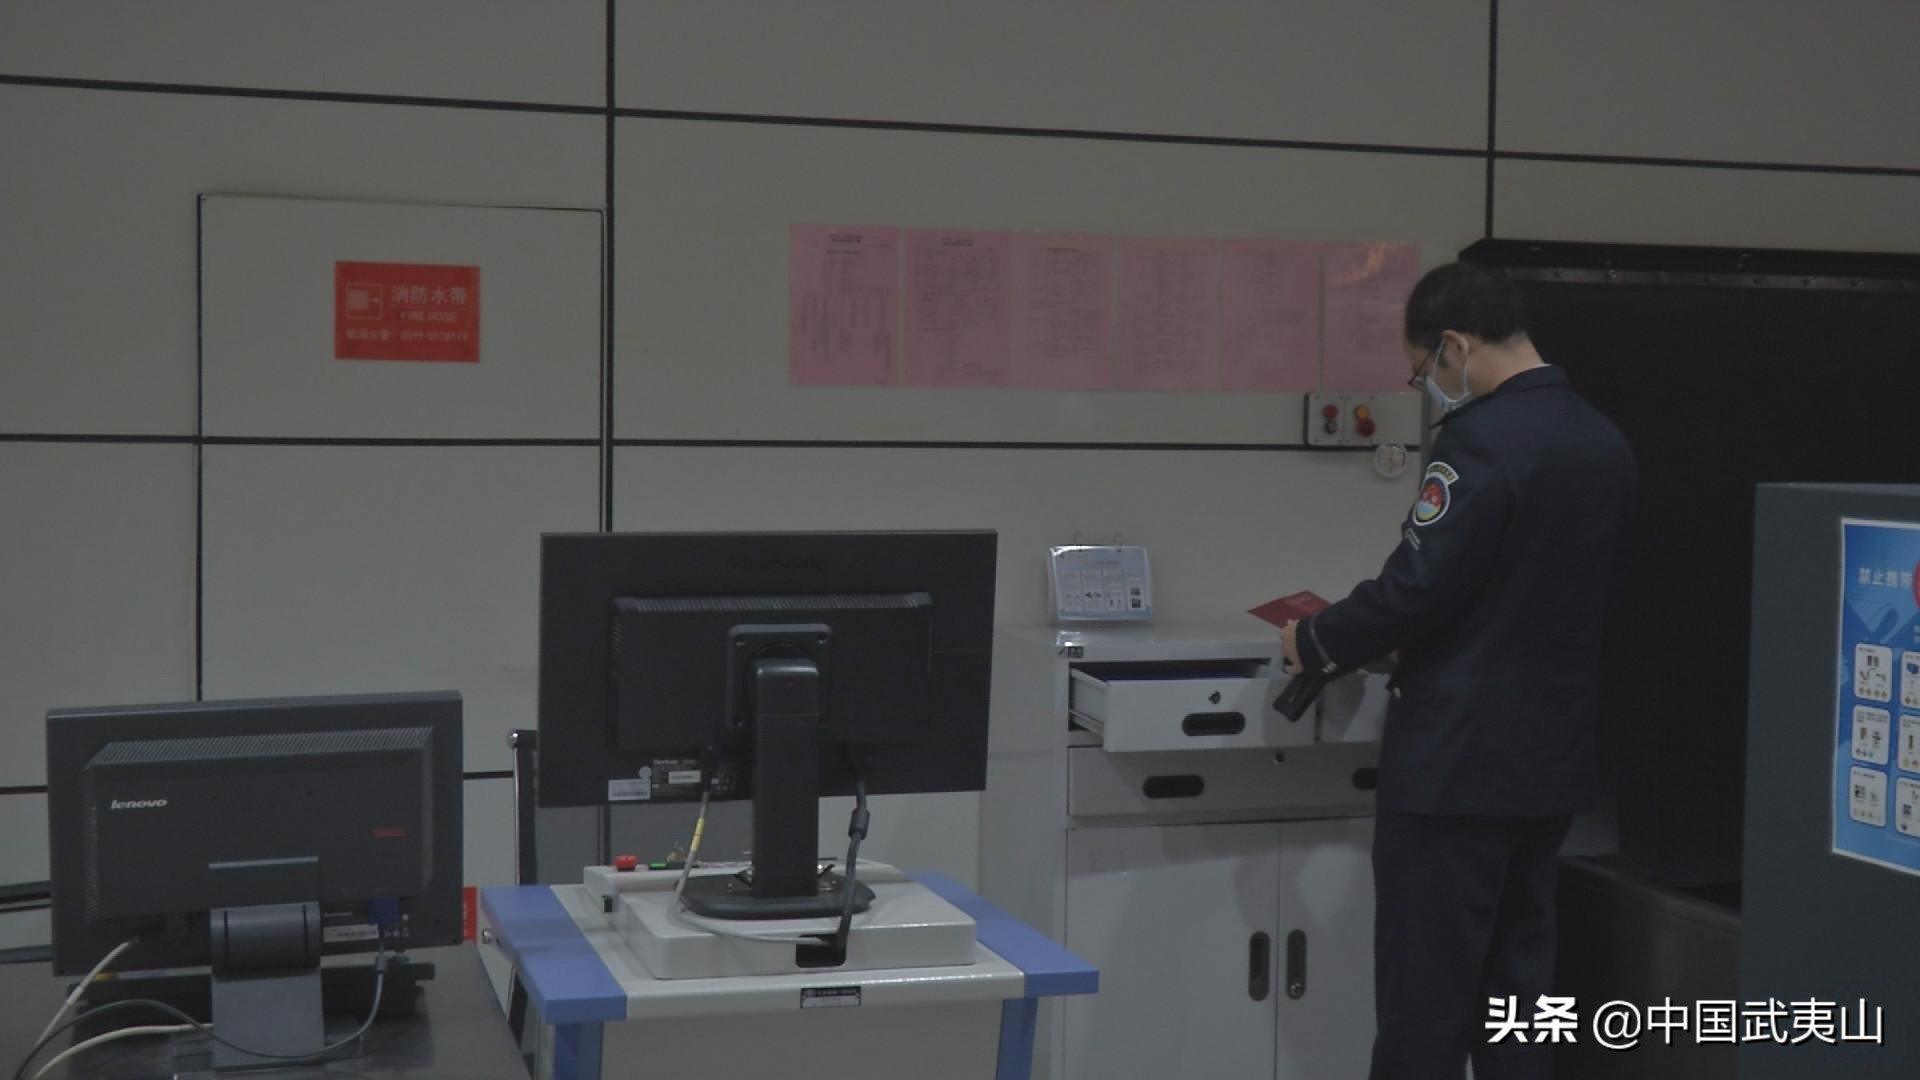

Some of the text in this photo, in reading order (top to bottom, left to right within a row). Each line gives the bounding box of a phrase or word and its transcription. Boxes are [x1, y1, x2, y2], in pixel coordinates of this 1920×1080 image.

[392, 285, 468, 304] 消防水带
[400, 311, 456, 322] FIRE HOSE
[110, 798, 168, 810] lenovo
